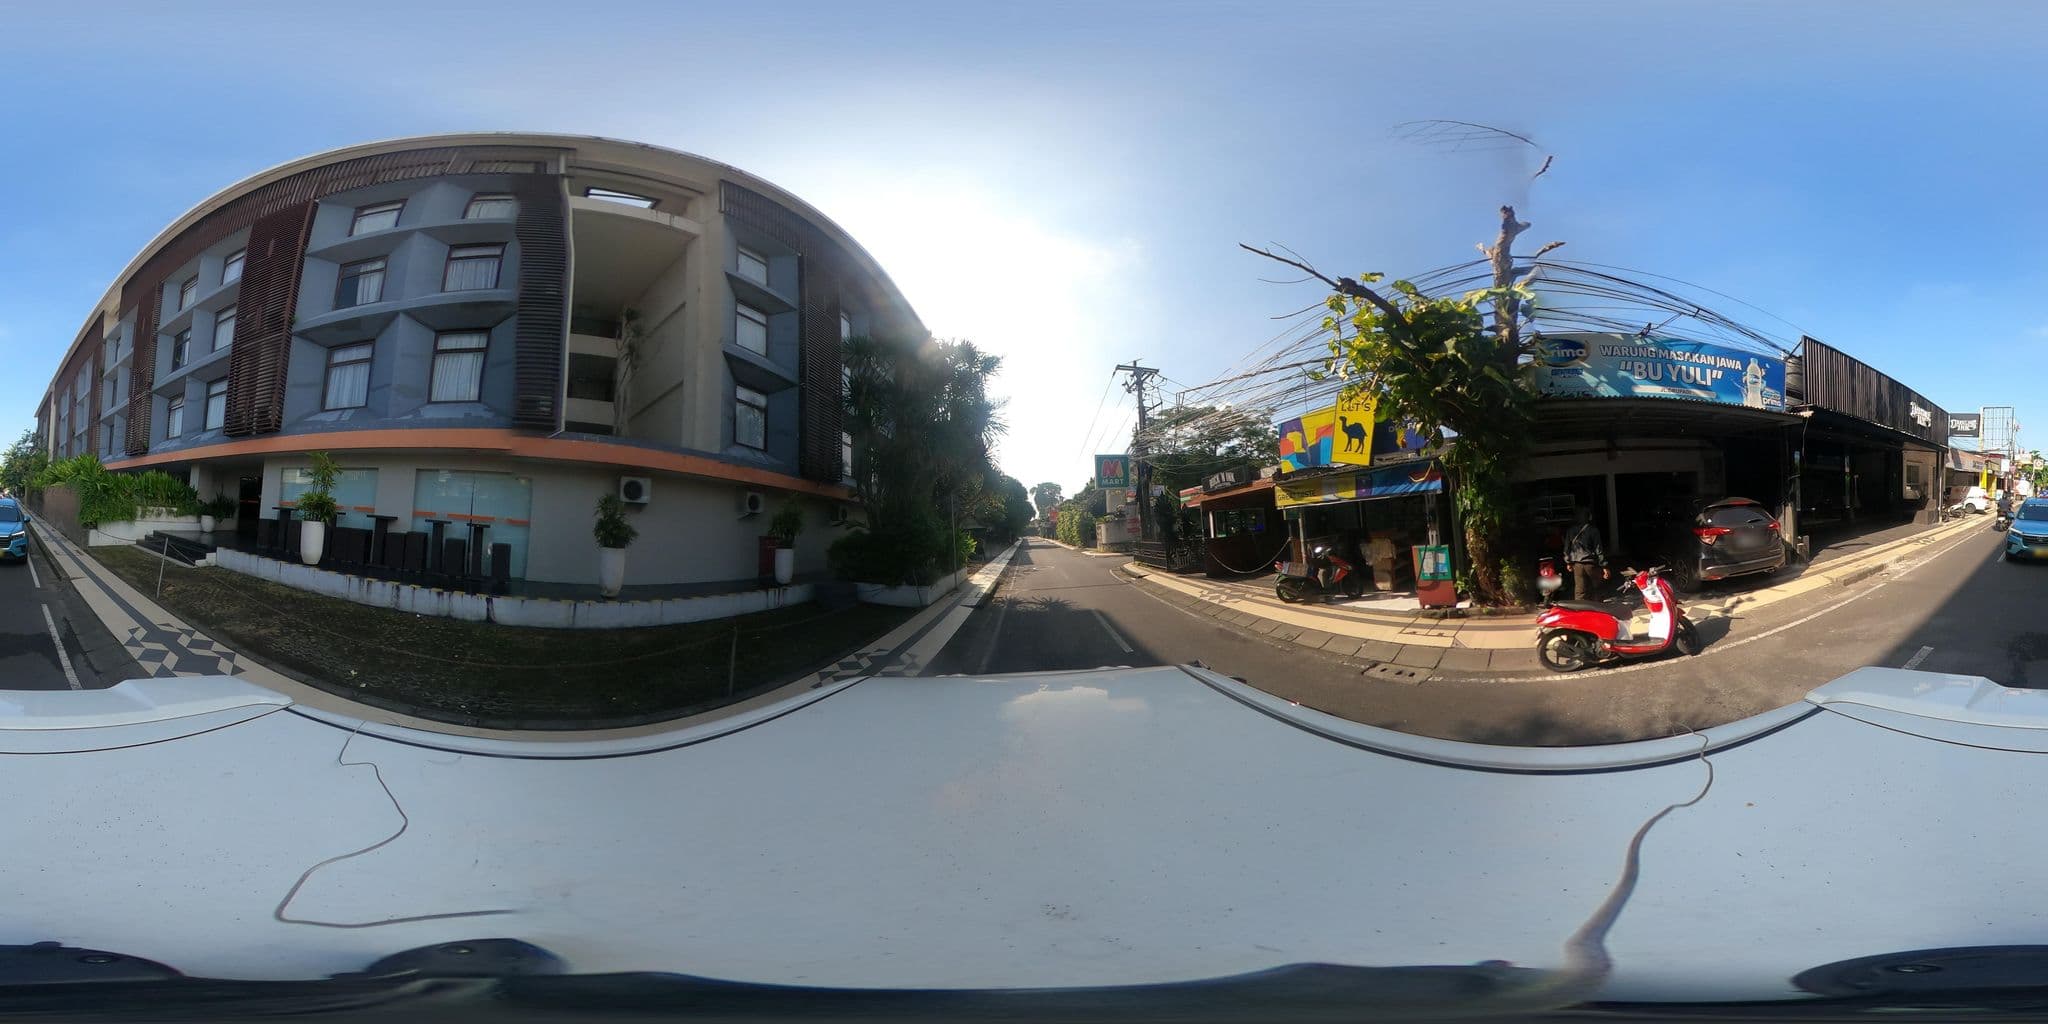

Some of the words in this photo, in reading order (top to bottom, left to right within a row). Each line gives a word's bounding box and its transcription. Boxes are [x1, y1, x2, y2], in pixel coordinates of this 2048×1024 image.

[1600, 344, 1656, 358] WARUNG
[1658, 349, 1715, 366] MASAKAN
[1716, 357, 1742, 371] JAWA
[1101, 478, 1124, 486] MART
